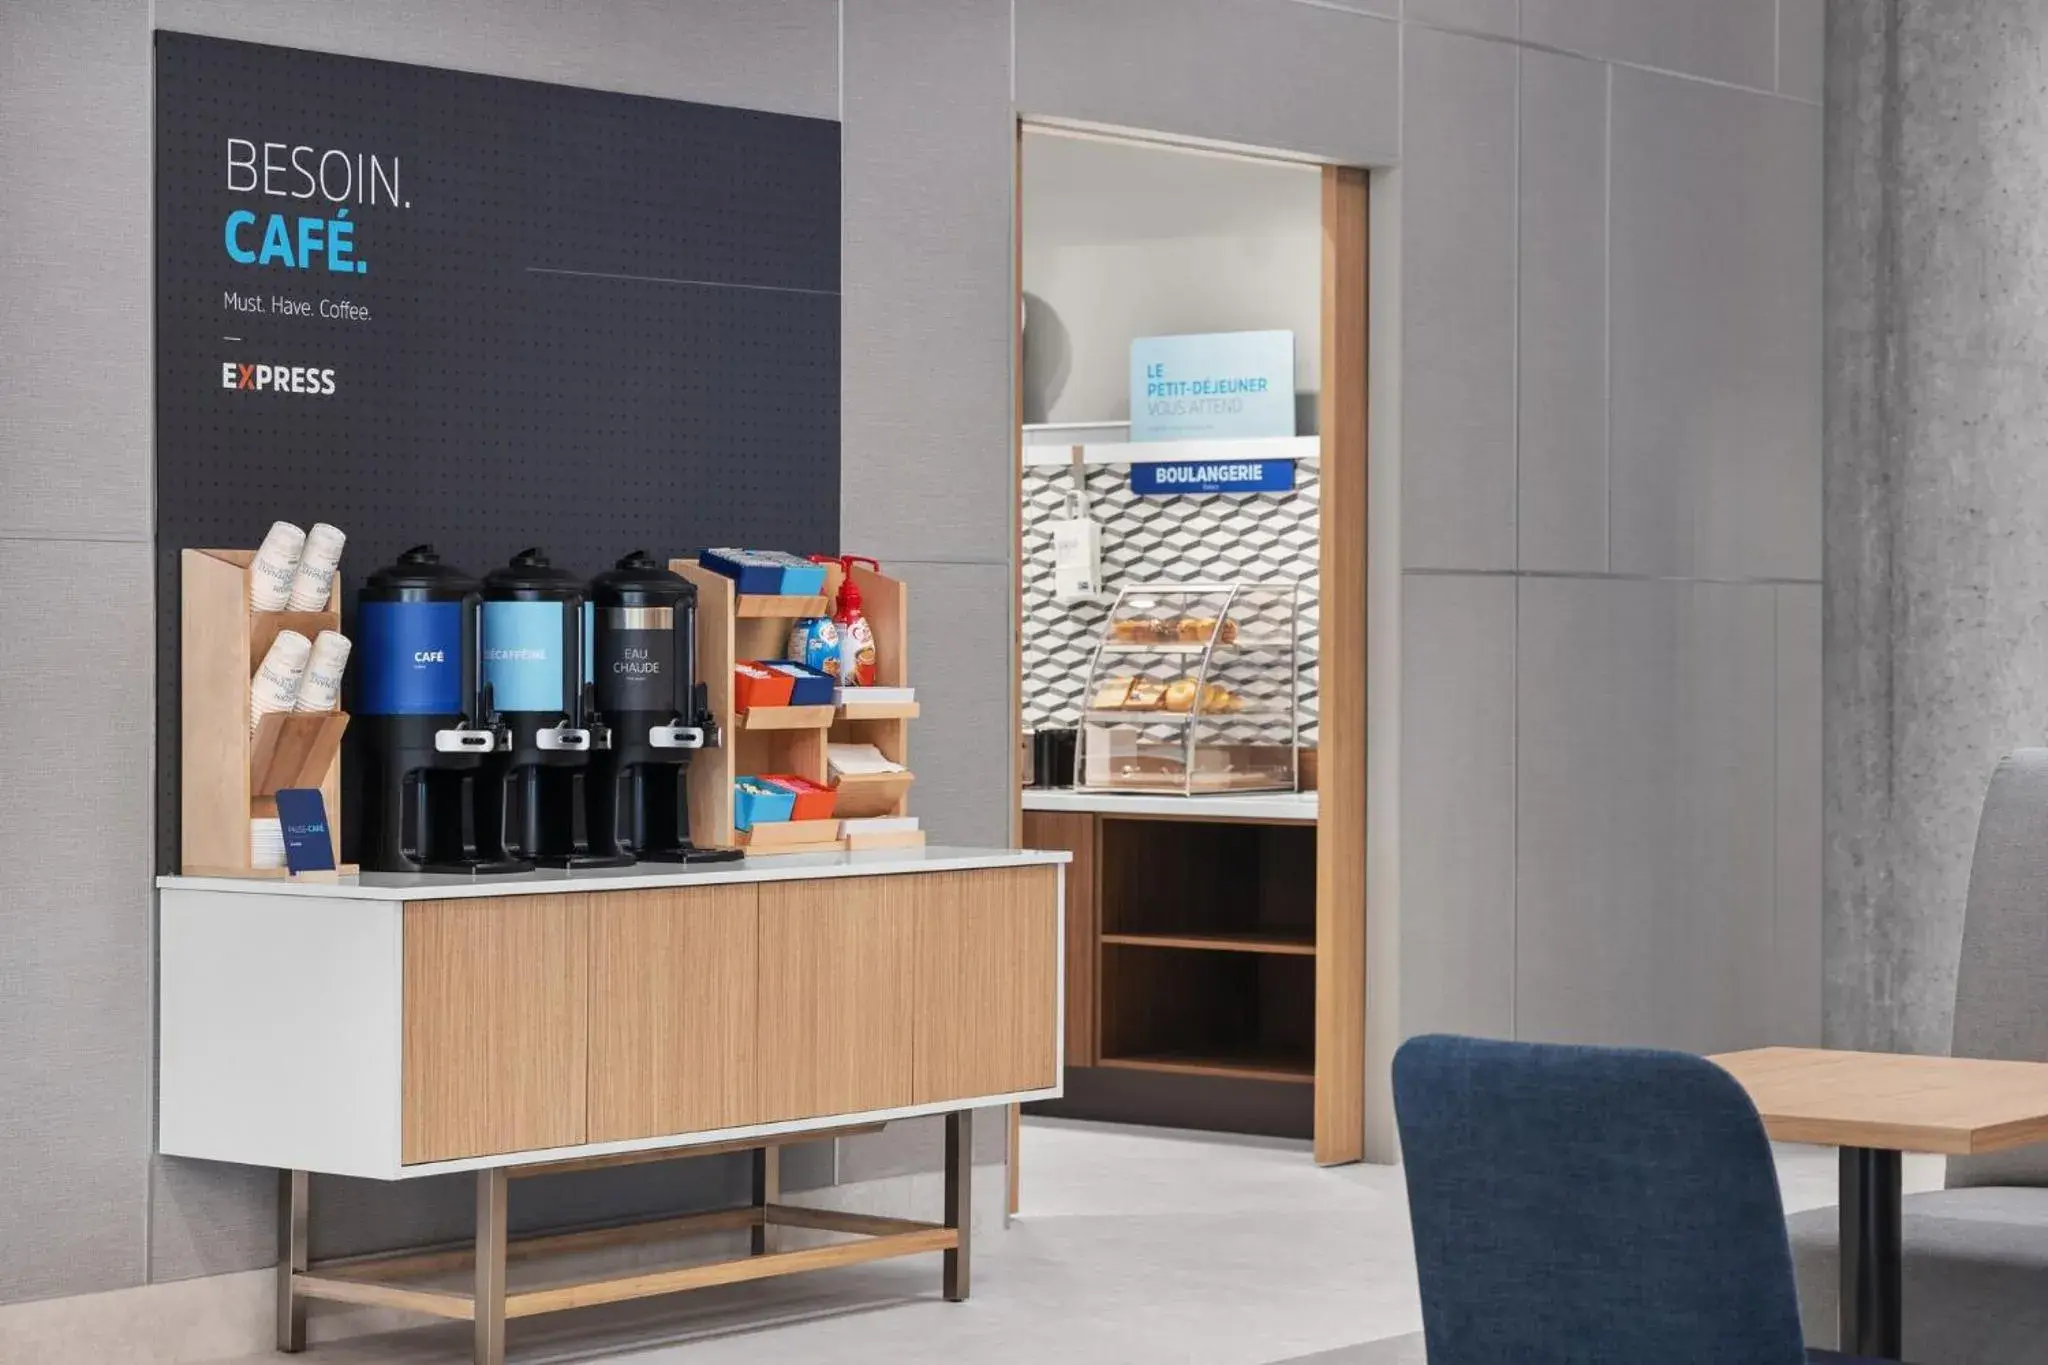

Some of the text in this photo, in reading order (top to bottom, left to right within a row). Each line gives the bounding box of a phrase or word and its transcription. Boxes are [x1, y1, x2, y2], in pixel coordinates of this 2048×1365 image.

[226, 138, 411, 209] BESOIN.
[224, 208, 367, 274] CAFÉ.
[223, 291, 373, 321] Must. Have. Coffee.
[222, 362, 336, 395] EXPRESS
[1147, 363, 1164, 378] LE
[1147, 376, 1268, 397] PETIT-DÉJEUNER
[1147, 397, 1243, 416] VOUS ATTEND
[1155, 464, 1263, 483] BOULANGERIE
[414, 650, 444, 662] CAFÉ
[624, 647, 648, 660] EAU
[613, 662, 660, 673] CHAUDE
